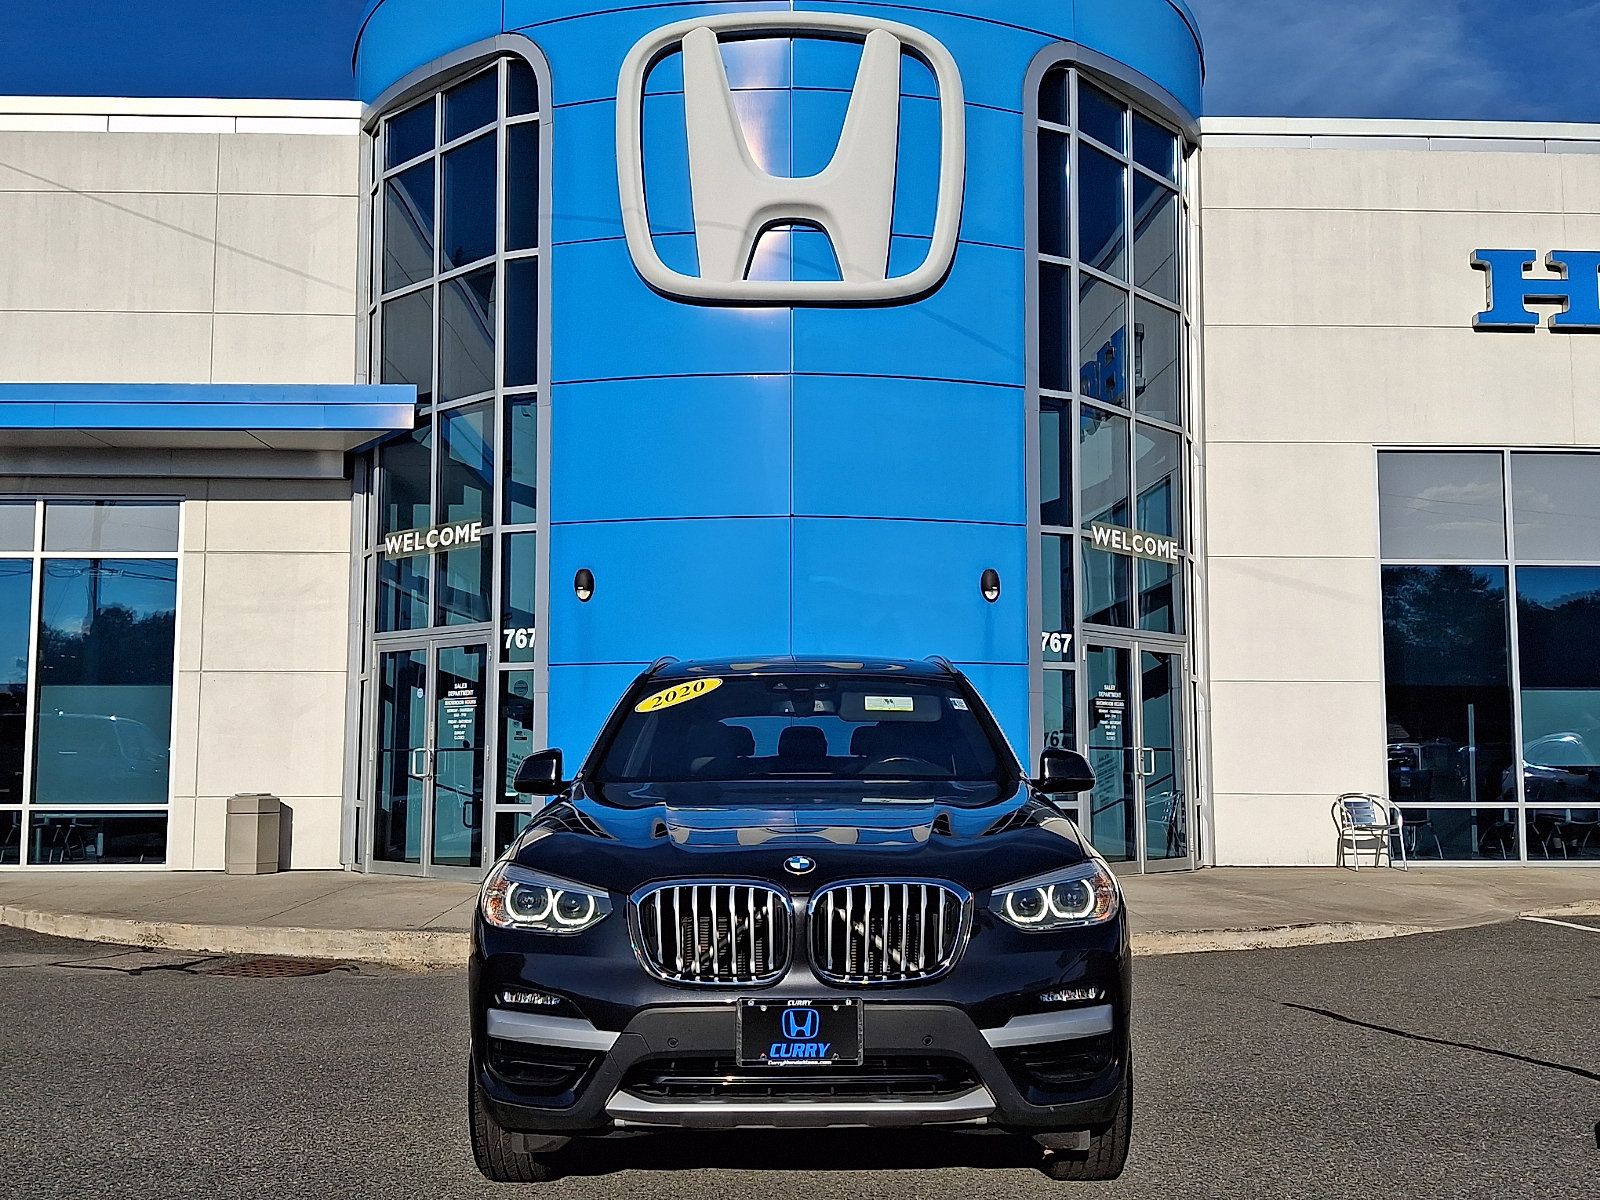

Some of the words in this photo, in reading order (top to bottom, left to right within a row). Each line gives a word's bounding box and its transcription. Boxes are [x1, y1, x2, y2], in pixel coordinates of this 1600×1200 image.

[385, 522, 481, 554] WELCOME
[1092, 525, 1178, 560] WELCOME
[503, 628, 536, 649] 767
[1041, 632, 1073, 653] 767
[651, 681, 705, 708] 2020
[769, 1043, 831, 1058] CURRY
